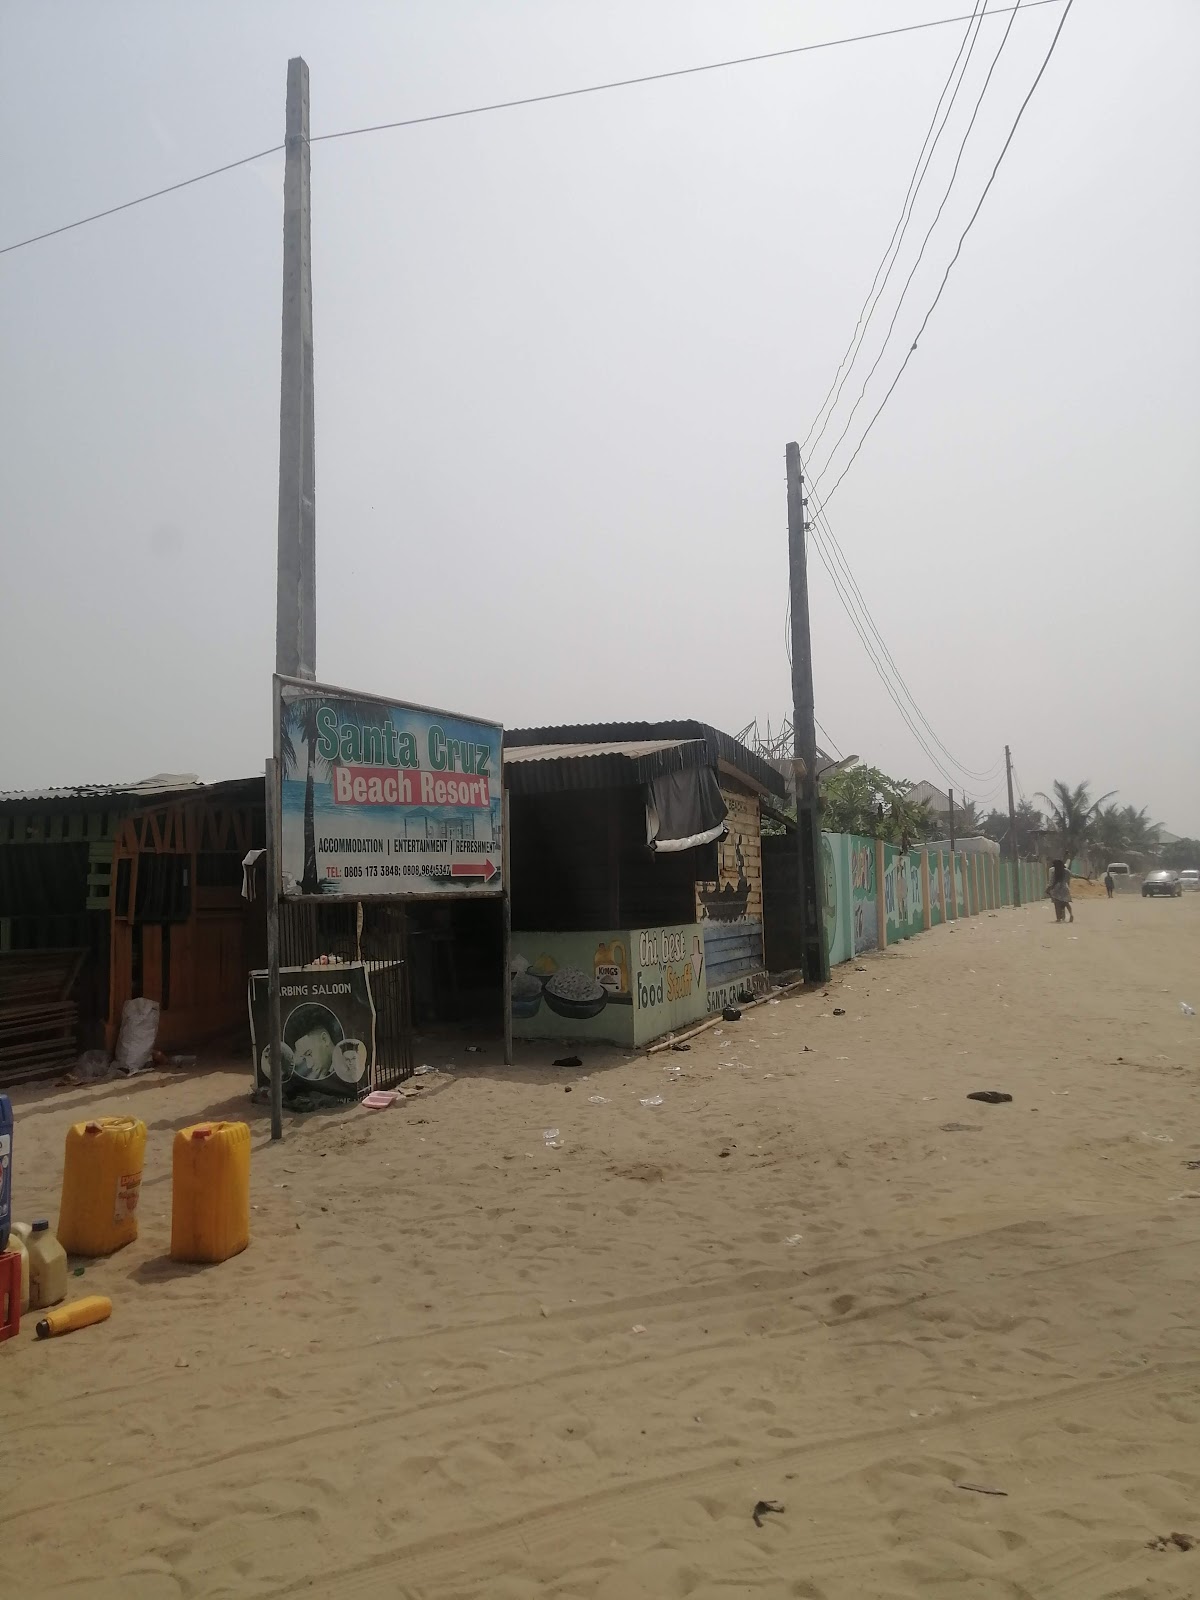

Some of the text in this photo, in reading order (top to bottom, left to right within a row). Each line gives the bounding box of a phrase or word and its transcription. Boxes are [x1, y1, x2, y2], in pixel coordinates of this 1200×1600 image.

[316, 706, 491, 777] Santa Cruz
[336, 767, 489, 806] Beach Resort
[318, 837, 496, 854] ACCOMMODATION ENTERTAINMENT REFRESHMENT
[326, 866, 342, 878] TEL:
[344, 866, 363, 878] 0805
[365, 866, 378, 877] 173
[598, 967, 619, 976] KINGS
[311, 983, 352, 995] SALOON
[637, 971, 664, 1010] Food
[706, 989, 727, 1012] SANTA
